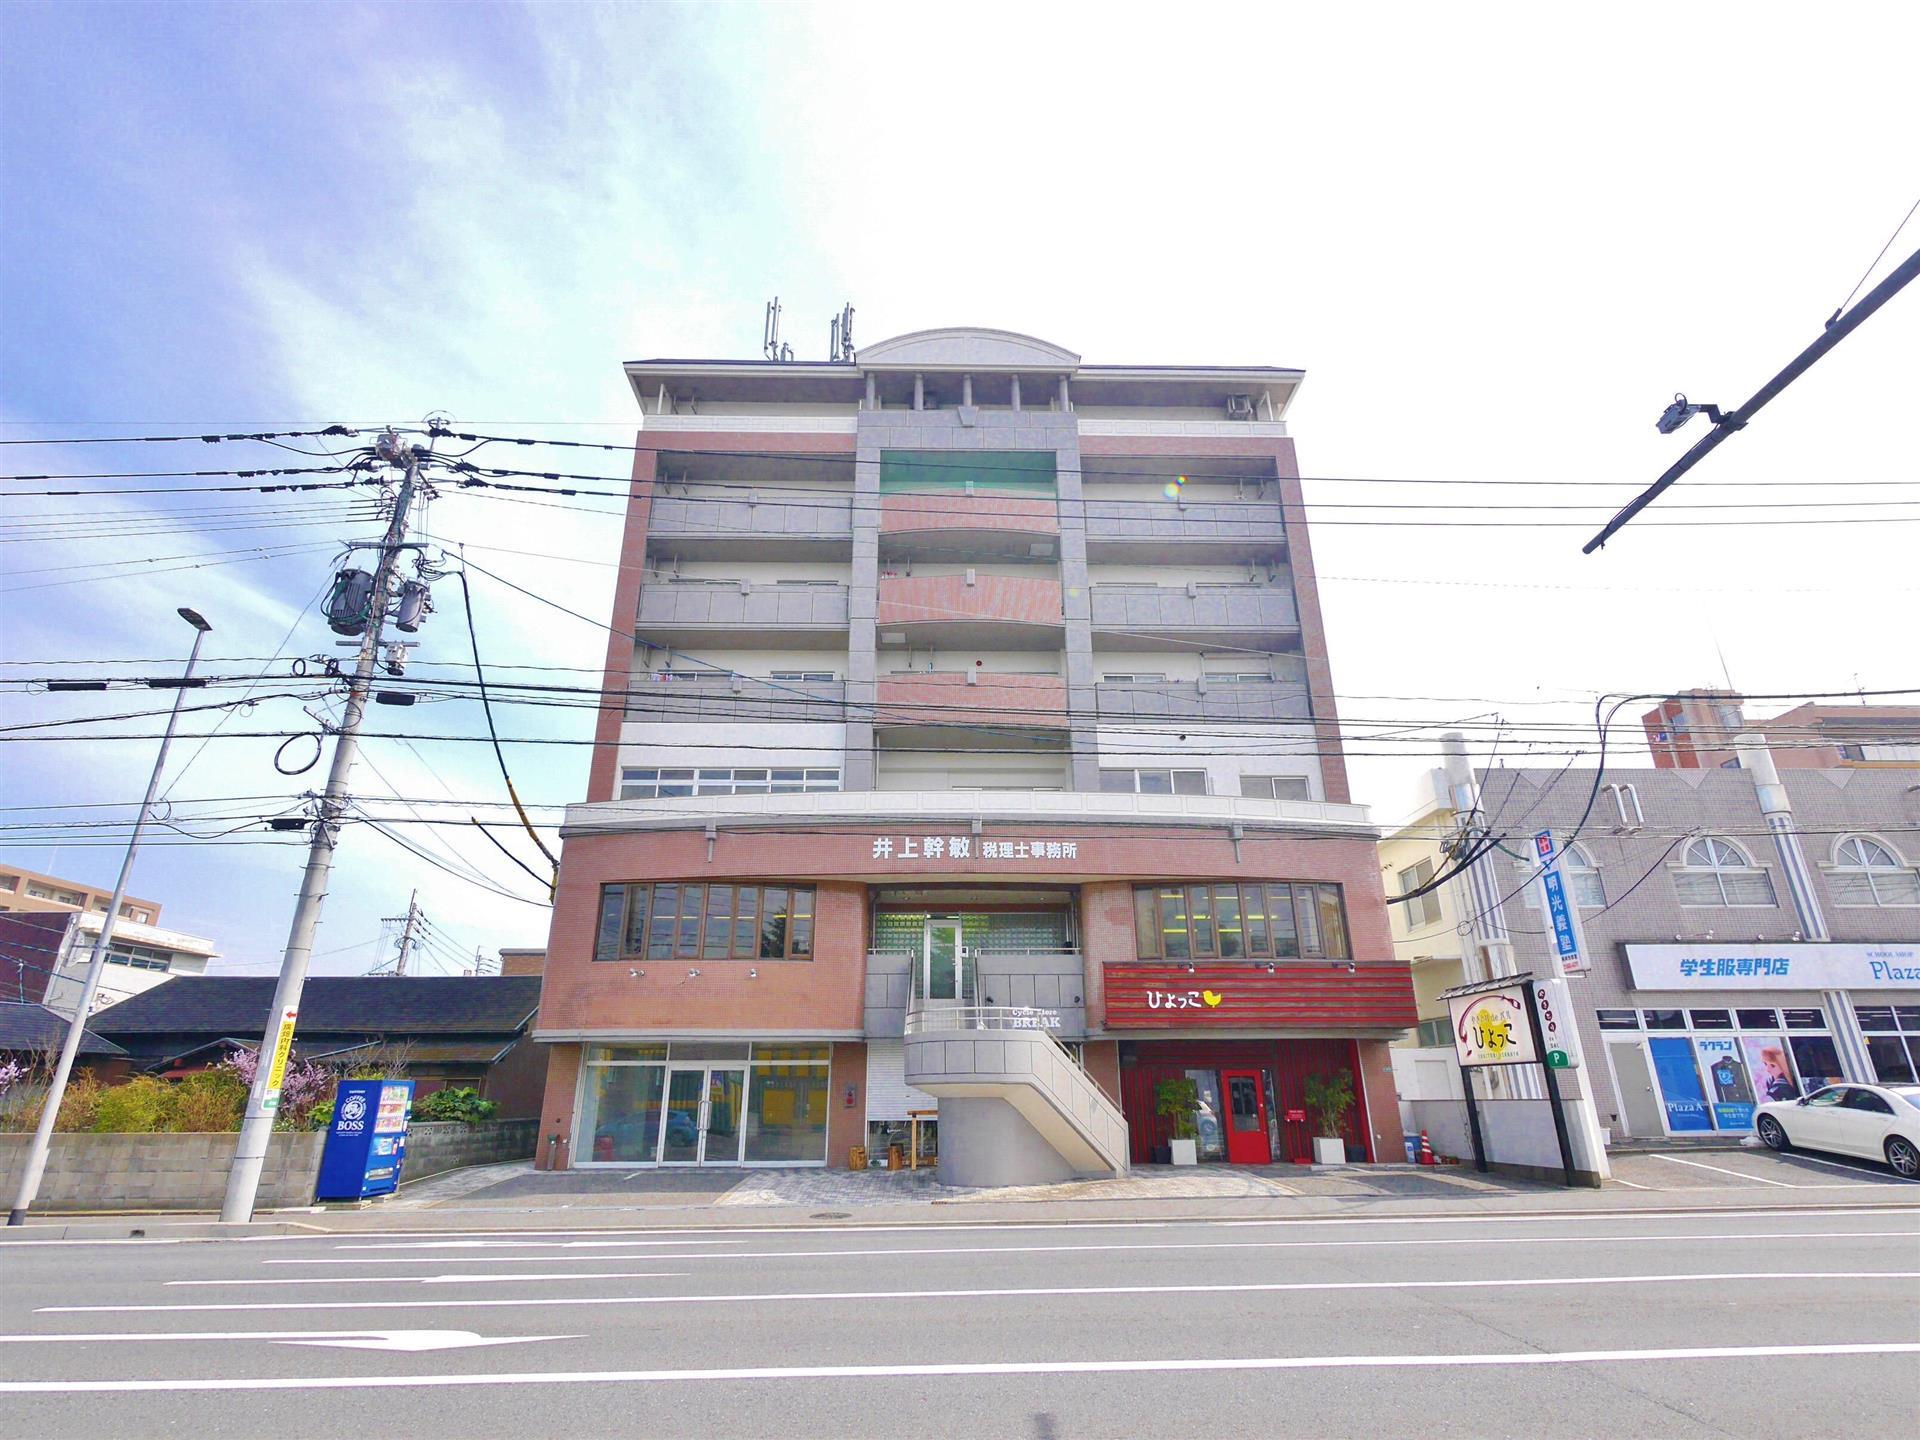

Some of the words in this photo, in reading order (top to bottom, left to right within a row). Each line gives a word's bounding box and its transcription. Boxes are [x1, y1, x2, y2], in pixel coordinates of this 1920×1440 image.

[982, 841, 1078, 859] 税理士事務所
[1547, 875, 1573, 952] 明光義塾
[1680, 958, 1790, 976] 学生服専門店
[1146, 991, 1202, 1009] ひょっこ
[1473, 1023, 1517, 1049] ひょっこ
[271, 1023, 293, 1088] 内科クリニック
[1553, 1053, 1560, 1064] P
[1667, 1102, 1694, 1112] Plaza
[336, 1120, 365, 1131] BOSS
